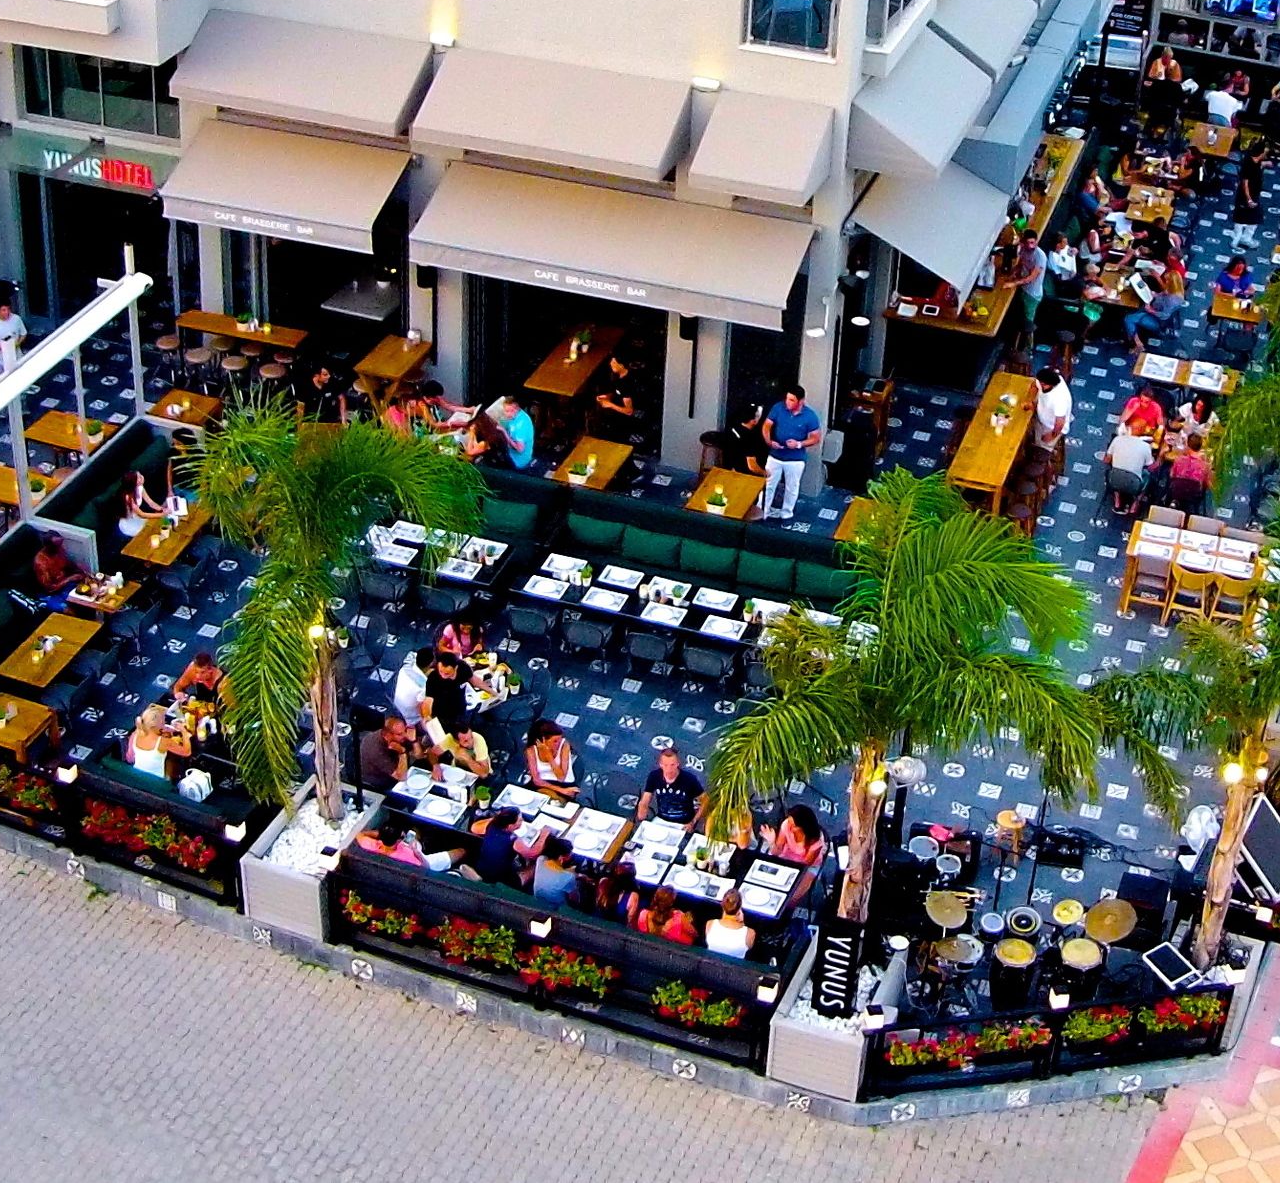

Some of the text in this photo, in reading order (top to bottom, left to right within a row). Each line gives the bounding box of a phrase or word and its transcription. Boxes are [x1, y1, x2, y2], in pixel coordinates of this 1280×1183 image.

[534, 269, 648, 298] CAFE BRASSERIE BAR
[819, 936, 853, 1010] YUNUS
